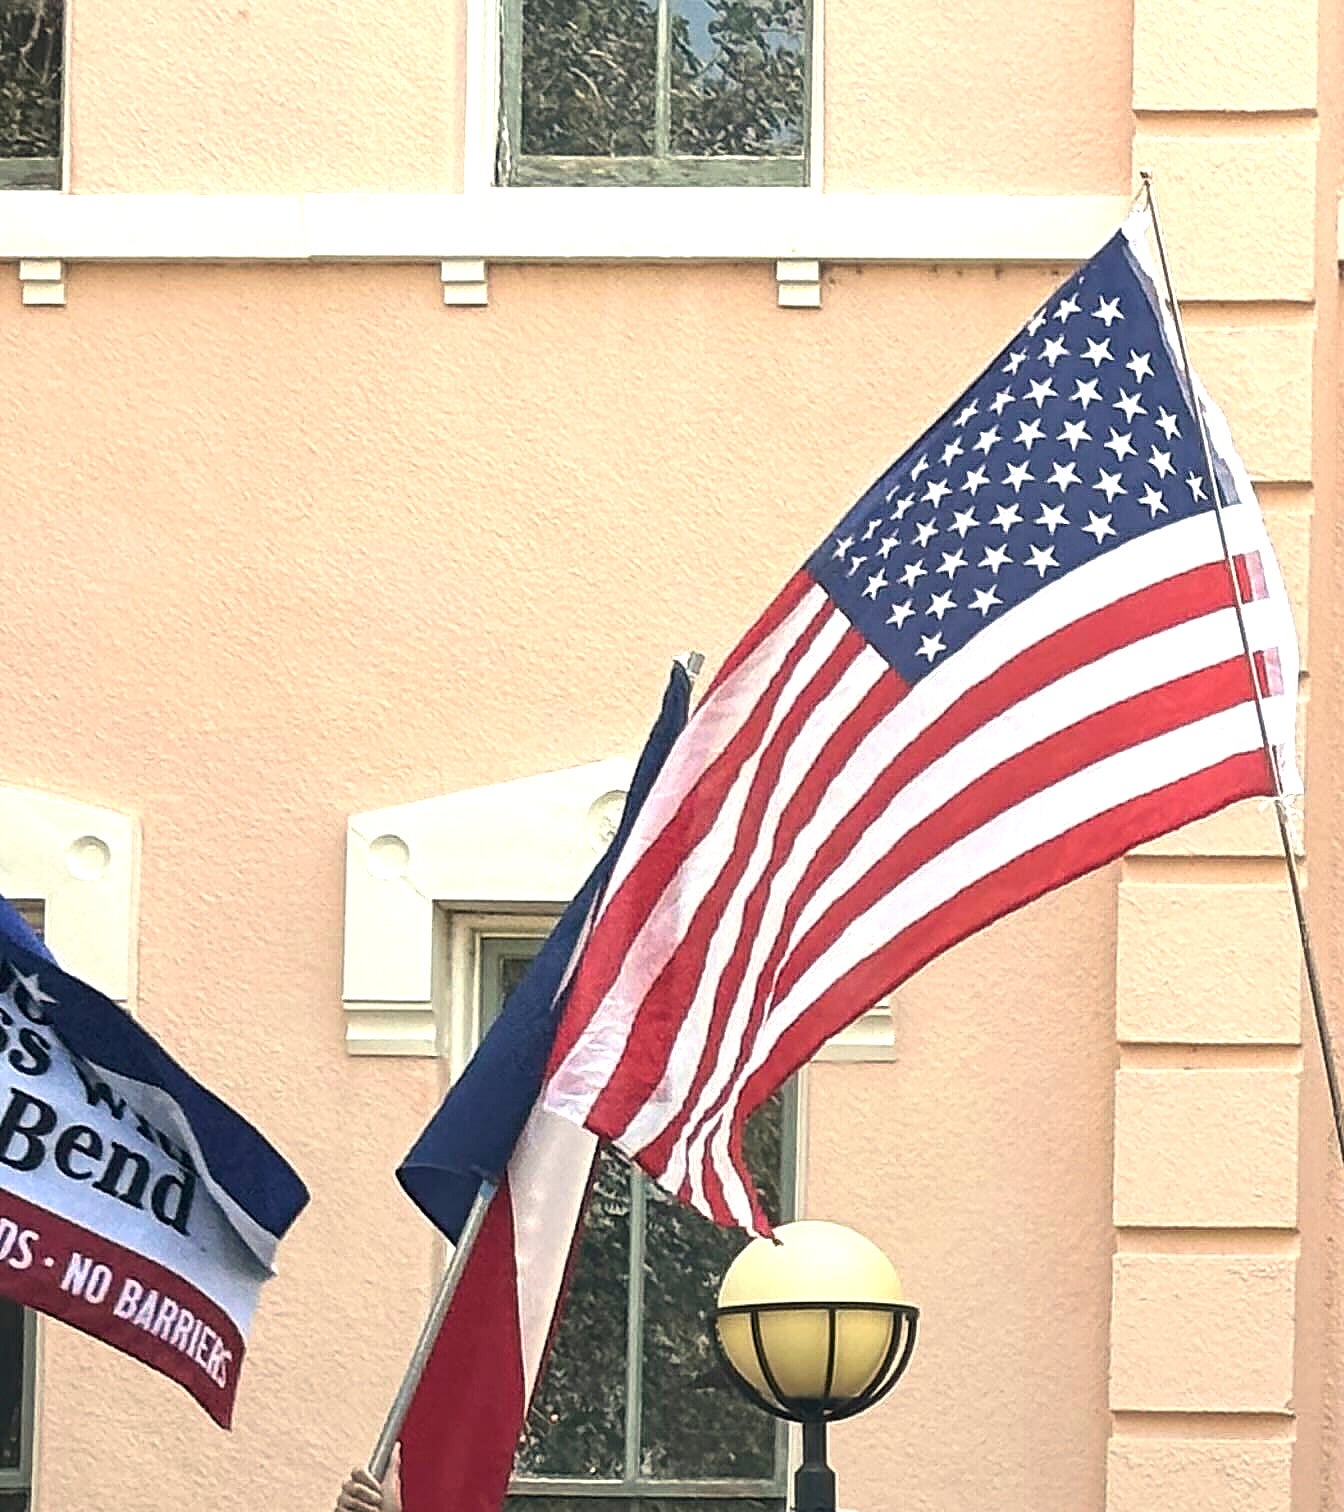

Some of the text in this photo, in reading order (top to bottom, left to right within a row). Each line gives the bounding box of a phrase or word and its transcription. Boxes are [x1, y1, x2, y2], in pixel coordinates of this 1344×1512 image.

[0, 1088, 198, 1236] Bend
[60, 1252, 114, 1305] NO
[113, 1278, 233, 1389] BARRIERS
